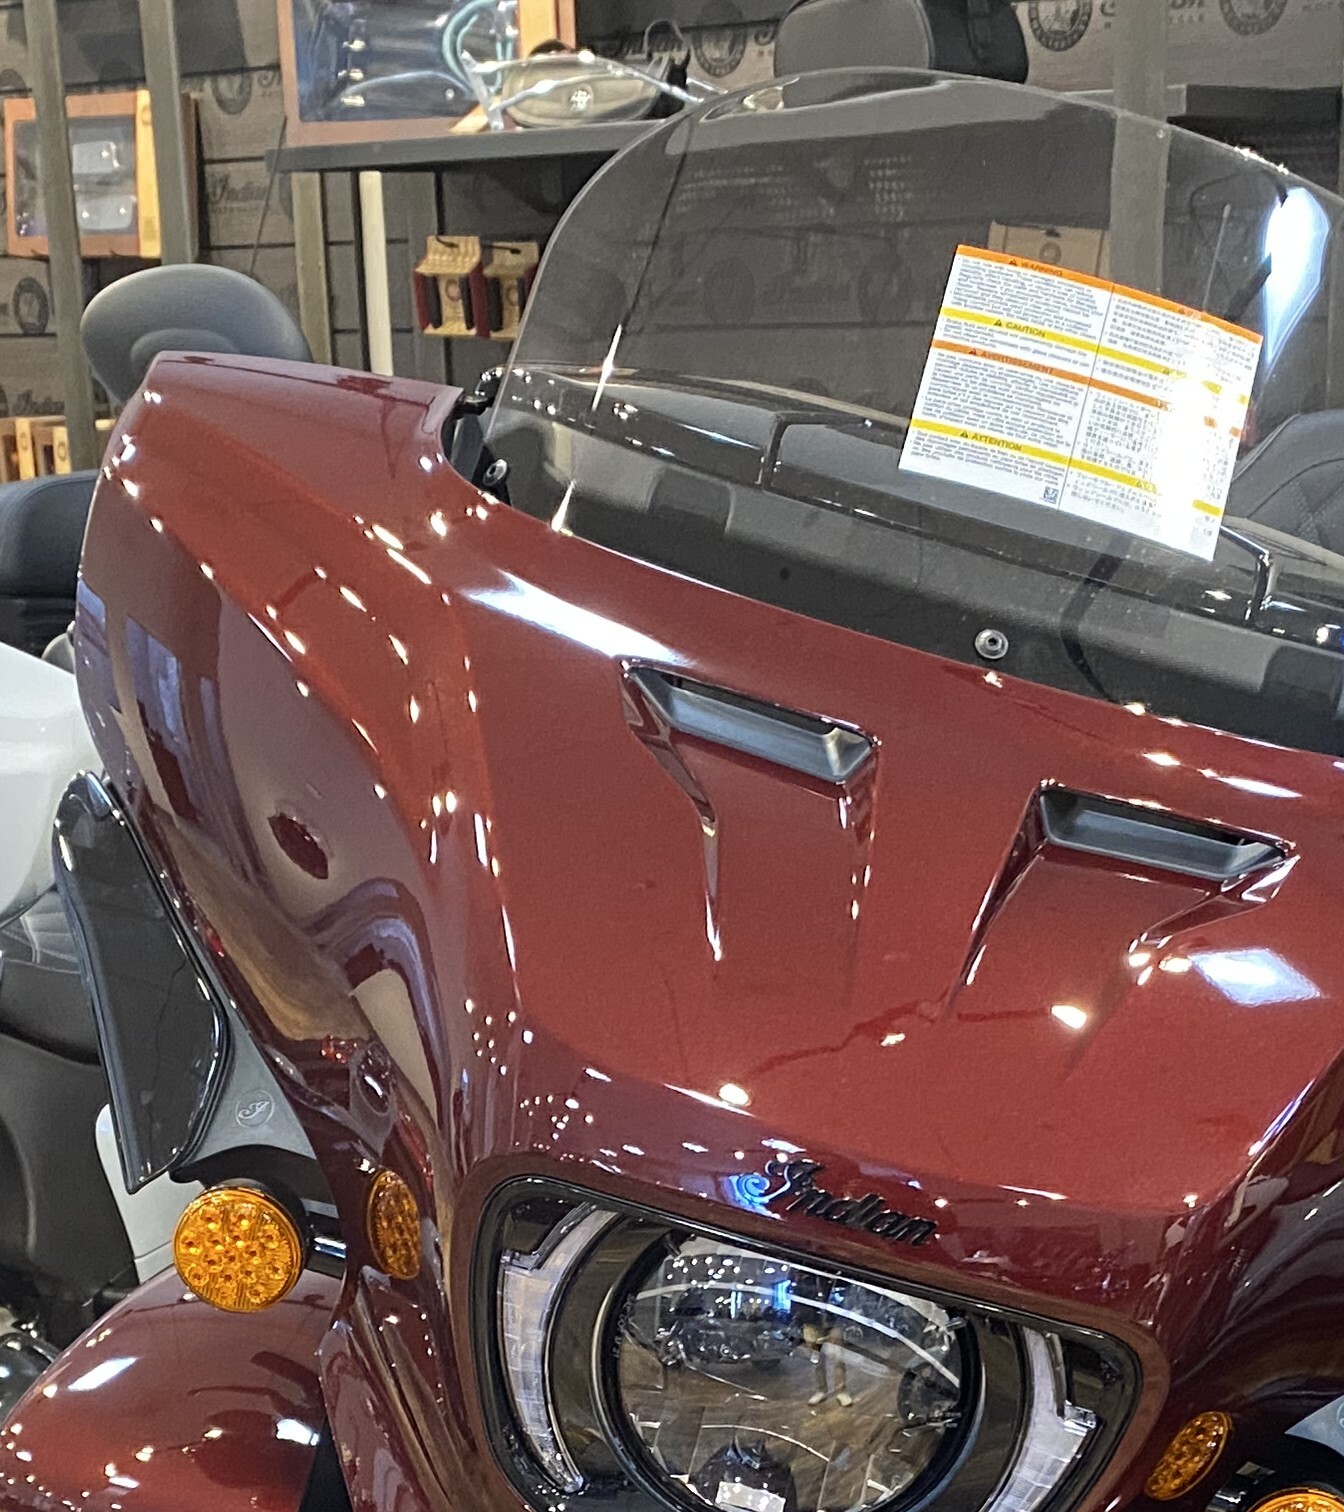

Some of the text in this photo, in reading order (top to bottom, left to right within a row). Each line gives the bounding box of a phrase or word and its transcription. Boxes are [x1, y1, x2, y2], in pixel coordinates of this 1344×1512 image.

[1021, 261, 1064, 278] WARNING
[1005, 320, 1047, 339] CAUTION
[981, 350, 1055, 375] AVERTISSEMENT
[971, 431, 1023, 452] ATTENTION
[739, 1158, 940, 1247] Indian
